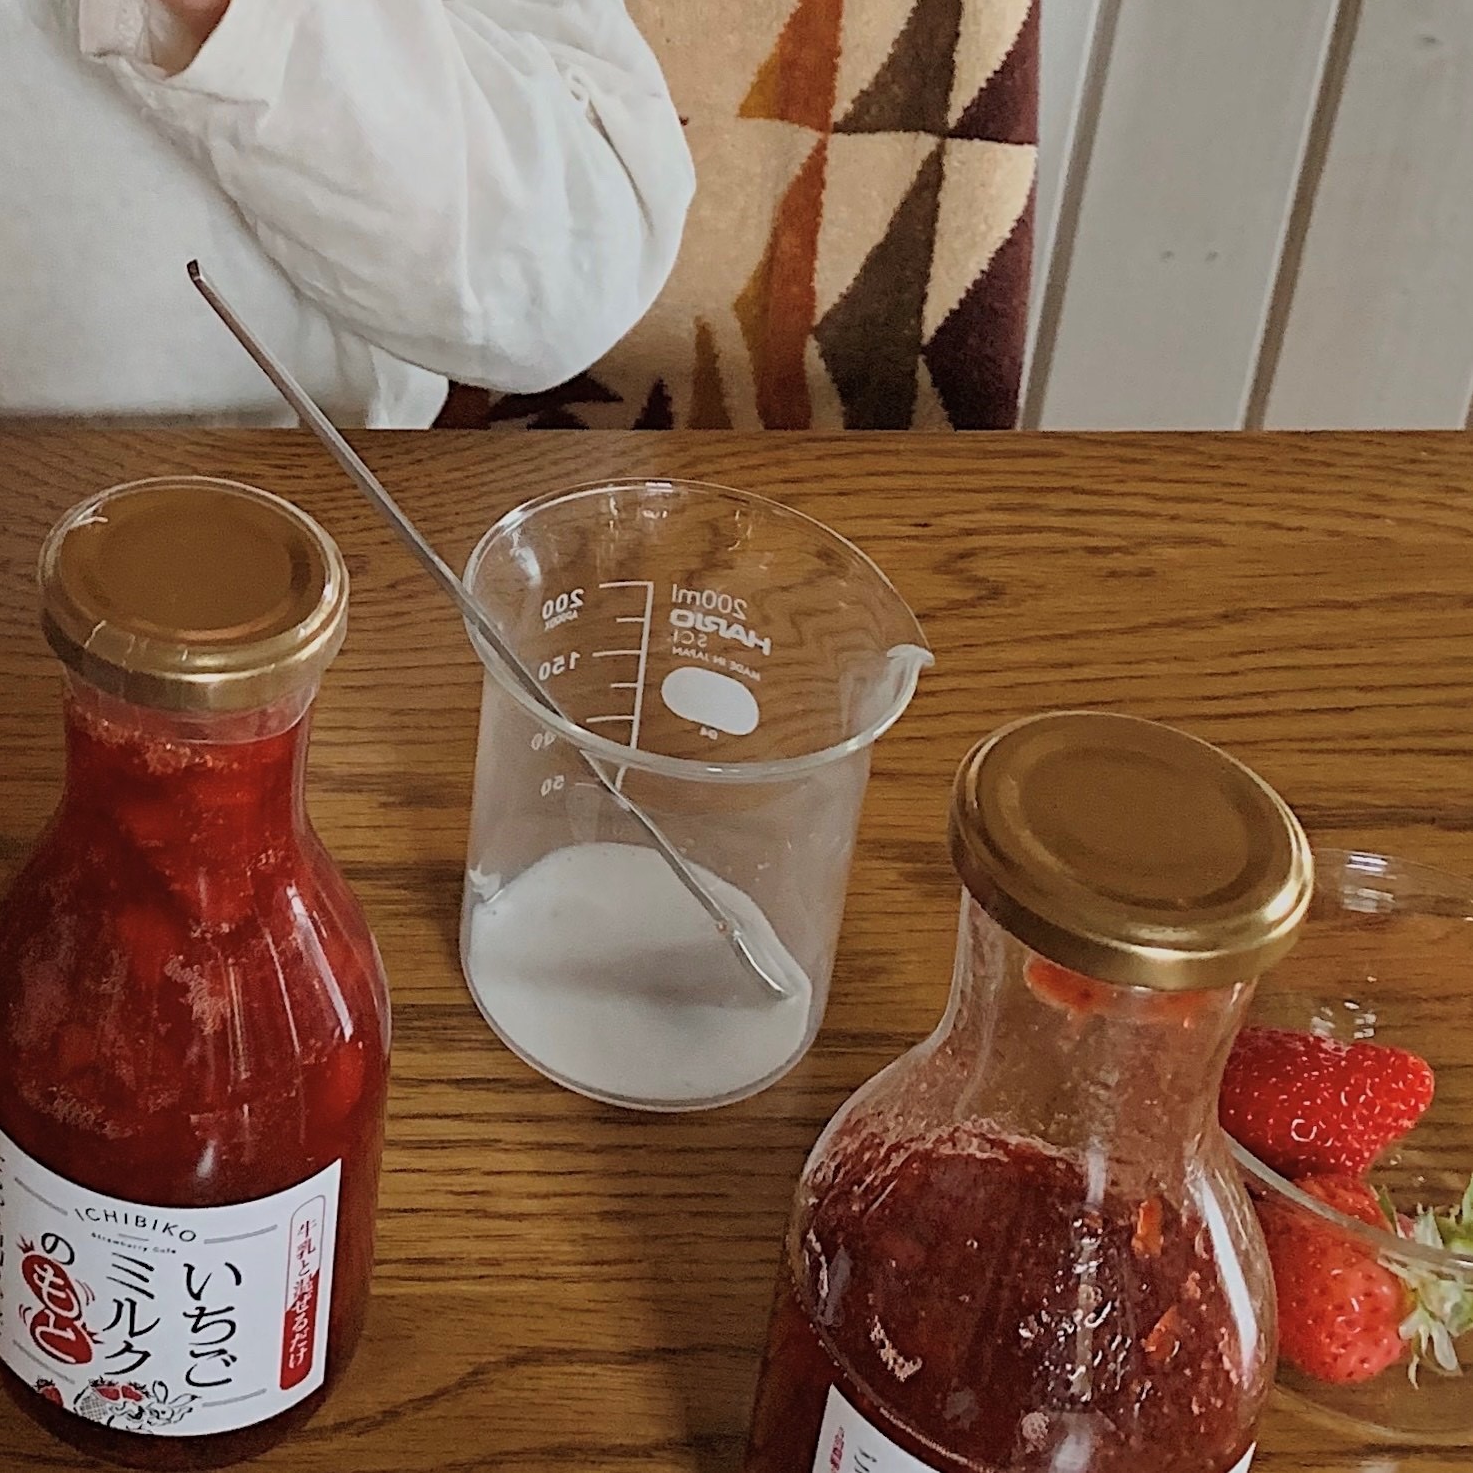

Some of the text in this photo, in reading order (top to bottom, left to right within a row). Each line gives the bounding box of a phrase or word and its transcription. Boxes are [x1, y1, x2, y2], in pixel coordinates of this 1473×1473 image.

[75, 1207, 197, 1243] ICHIBIKO
[102, 1251, 161, 1376] ミルク
[182, 1261, 242, 1388] いちご
